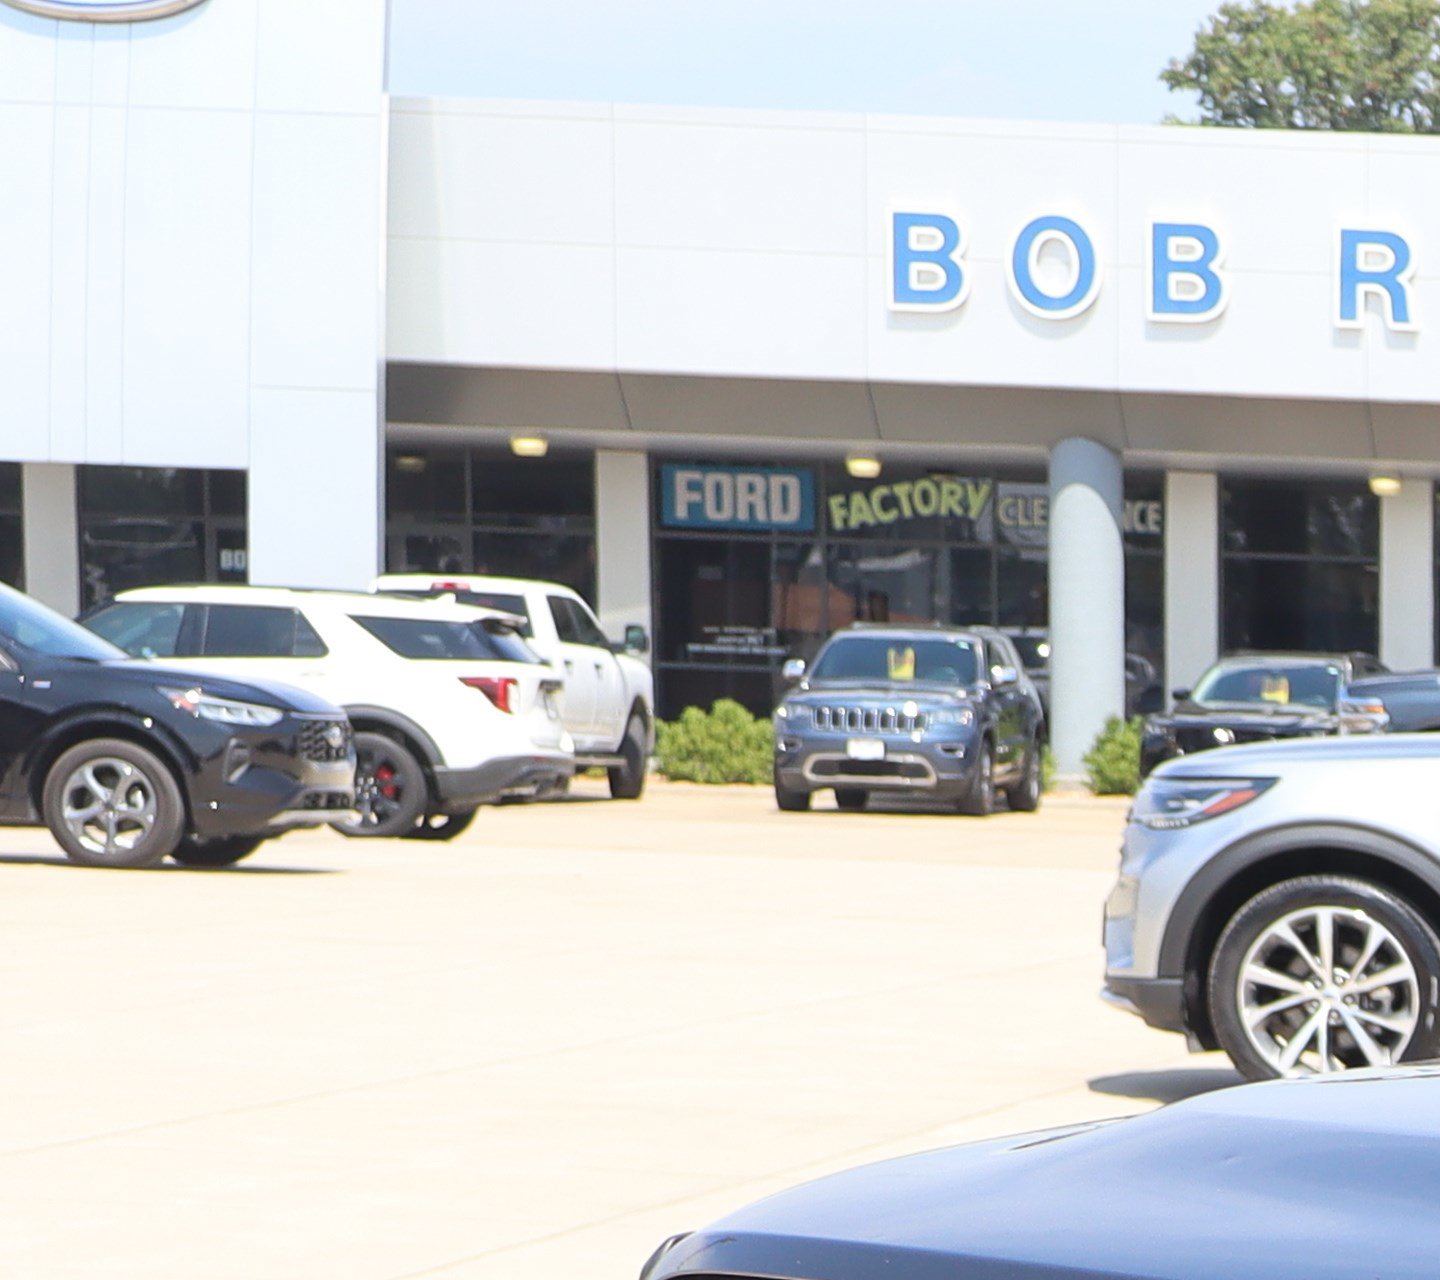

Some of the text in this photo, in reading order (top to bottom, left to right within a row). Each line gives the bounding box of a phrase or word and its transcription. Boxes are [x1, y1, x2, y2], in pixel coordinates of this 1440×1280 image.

[889, 210, 1227, 318] BOB
[674, 469, 1163, 536] FORD FACTORY CLENCE
